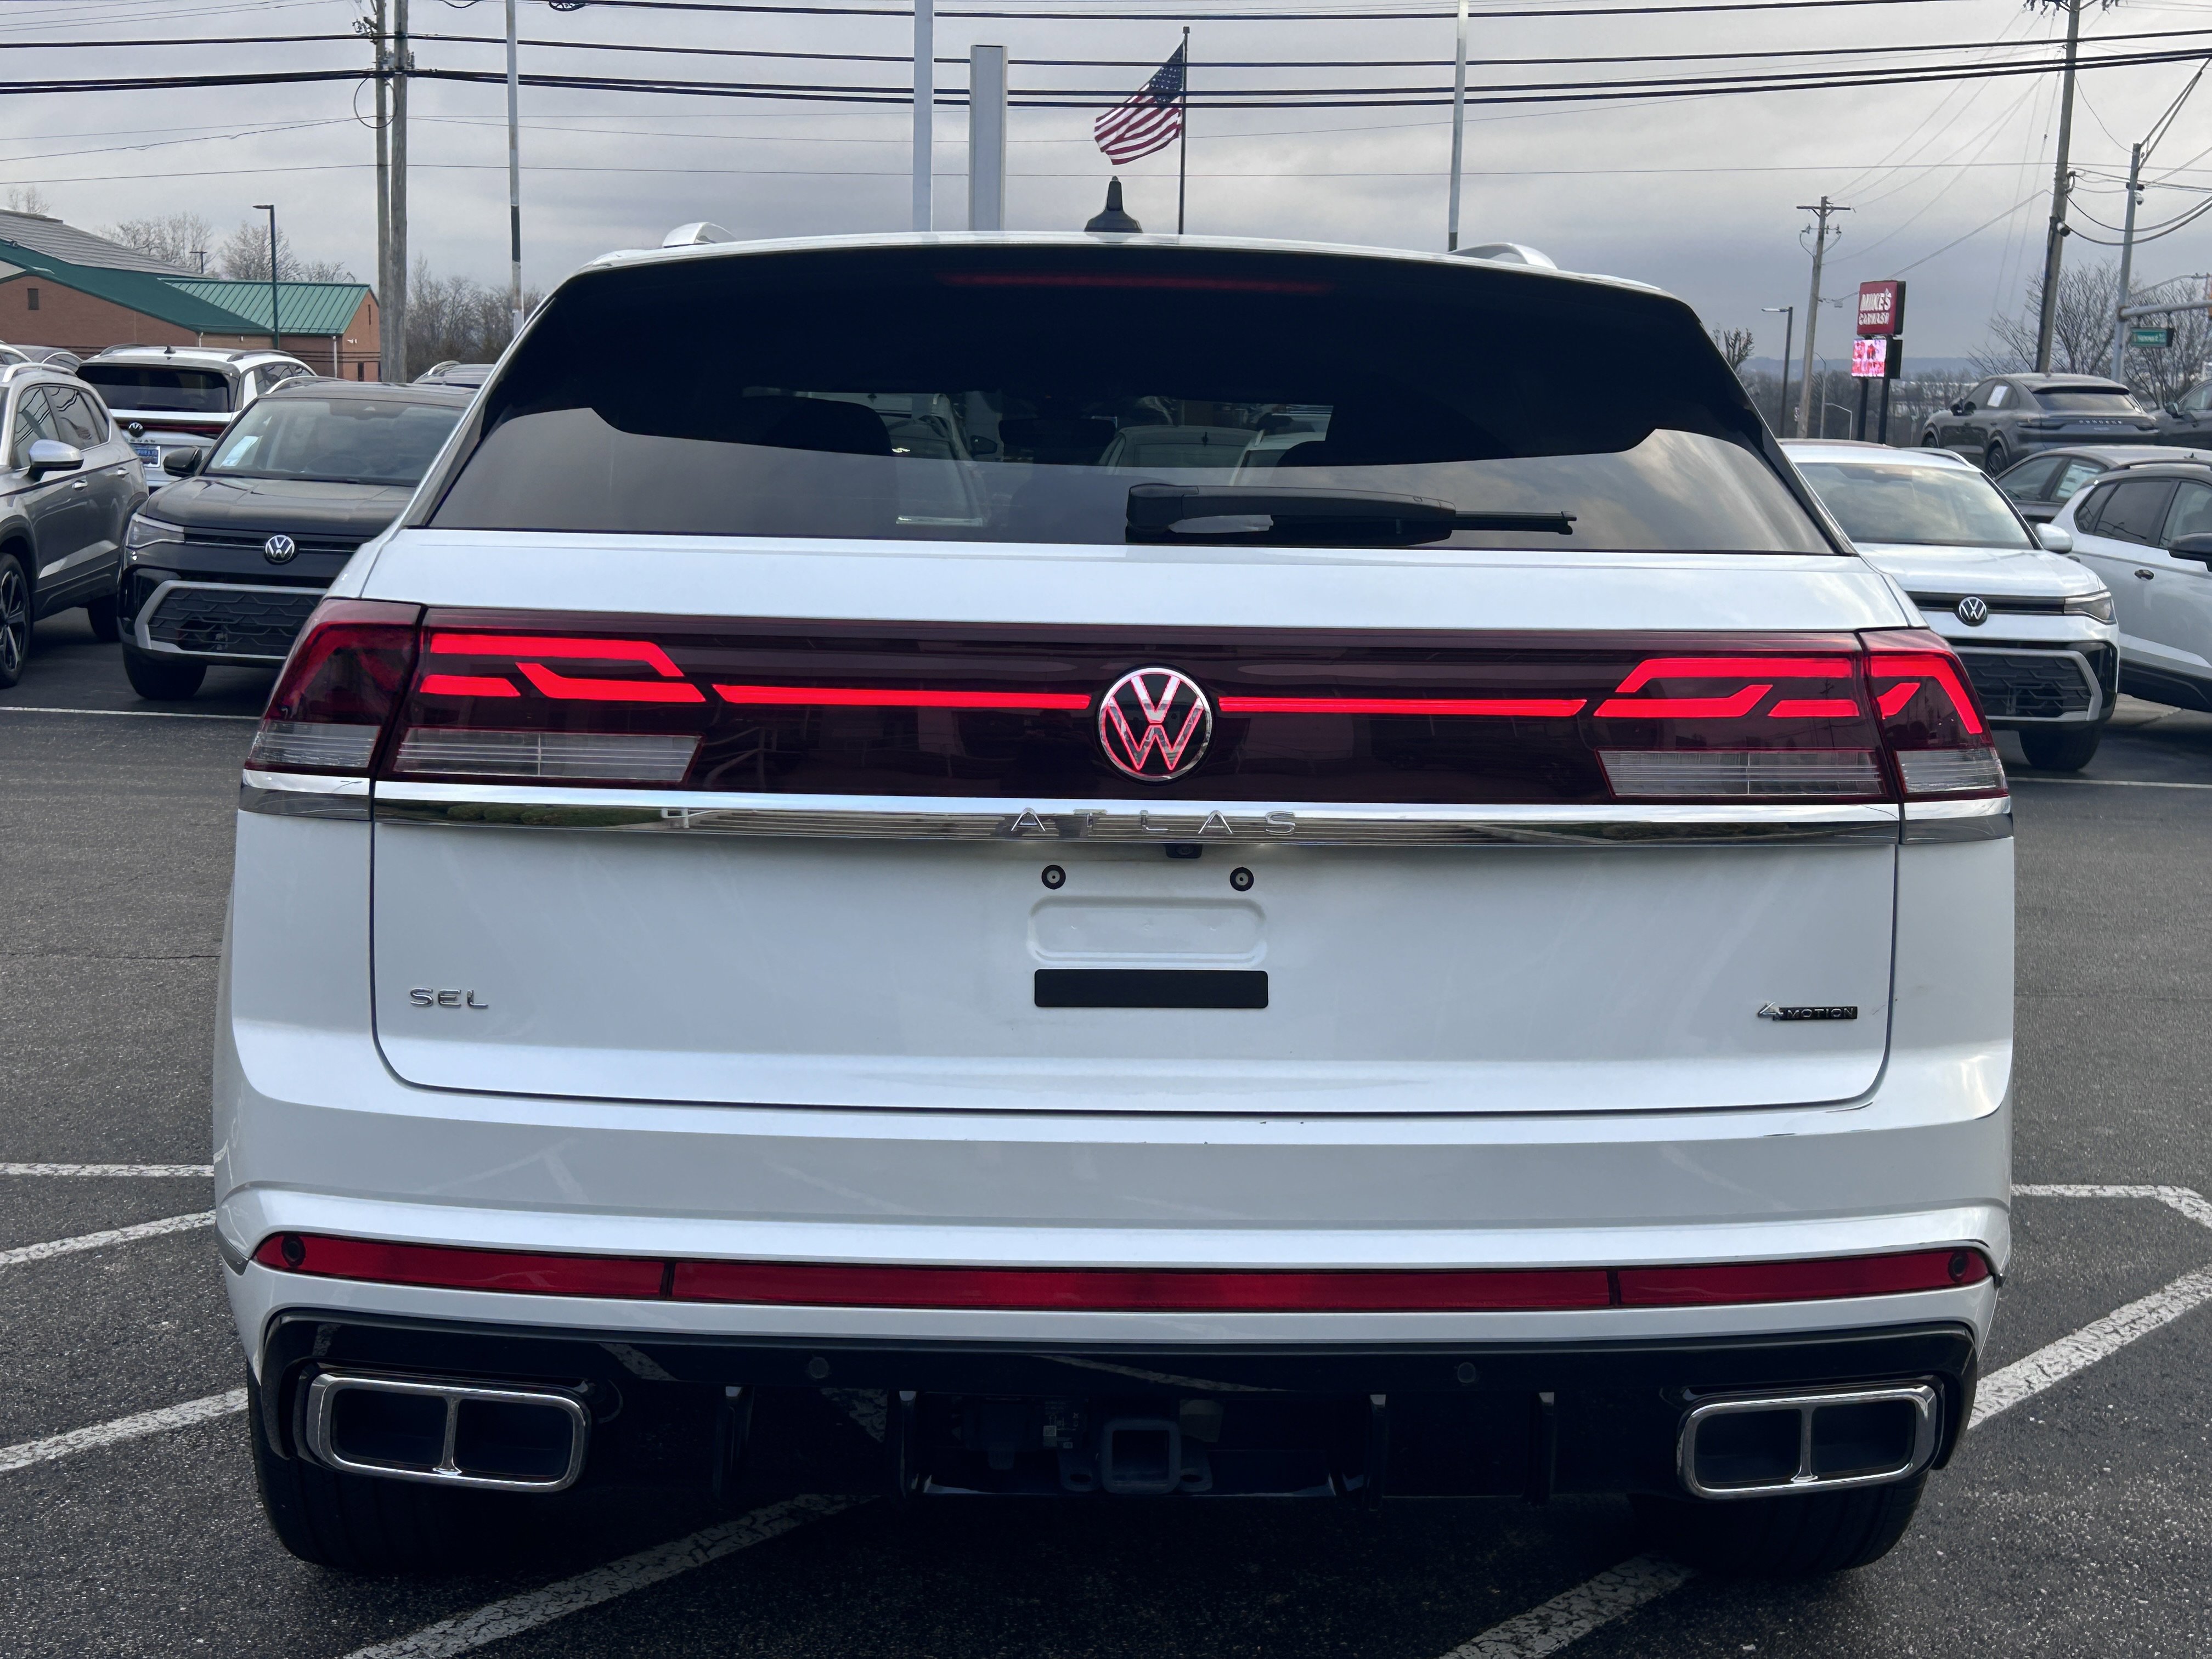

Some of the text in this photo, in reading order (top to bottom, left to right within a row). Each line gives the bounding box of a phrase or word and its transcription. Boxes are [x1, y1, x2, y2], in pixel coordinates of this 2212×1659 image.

[266, 534, 295, 562] VW
[1102, 670, 1210, 776] VW
[1011, 806, 1296, 836] ATLAS
[410, 986, 489, 1008] SEL
[1757, 1001, 1855, 1019] 4MOTION
